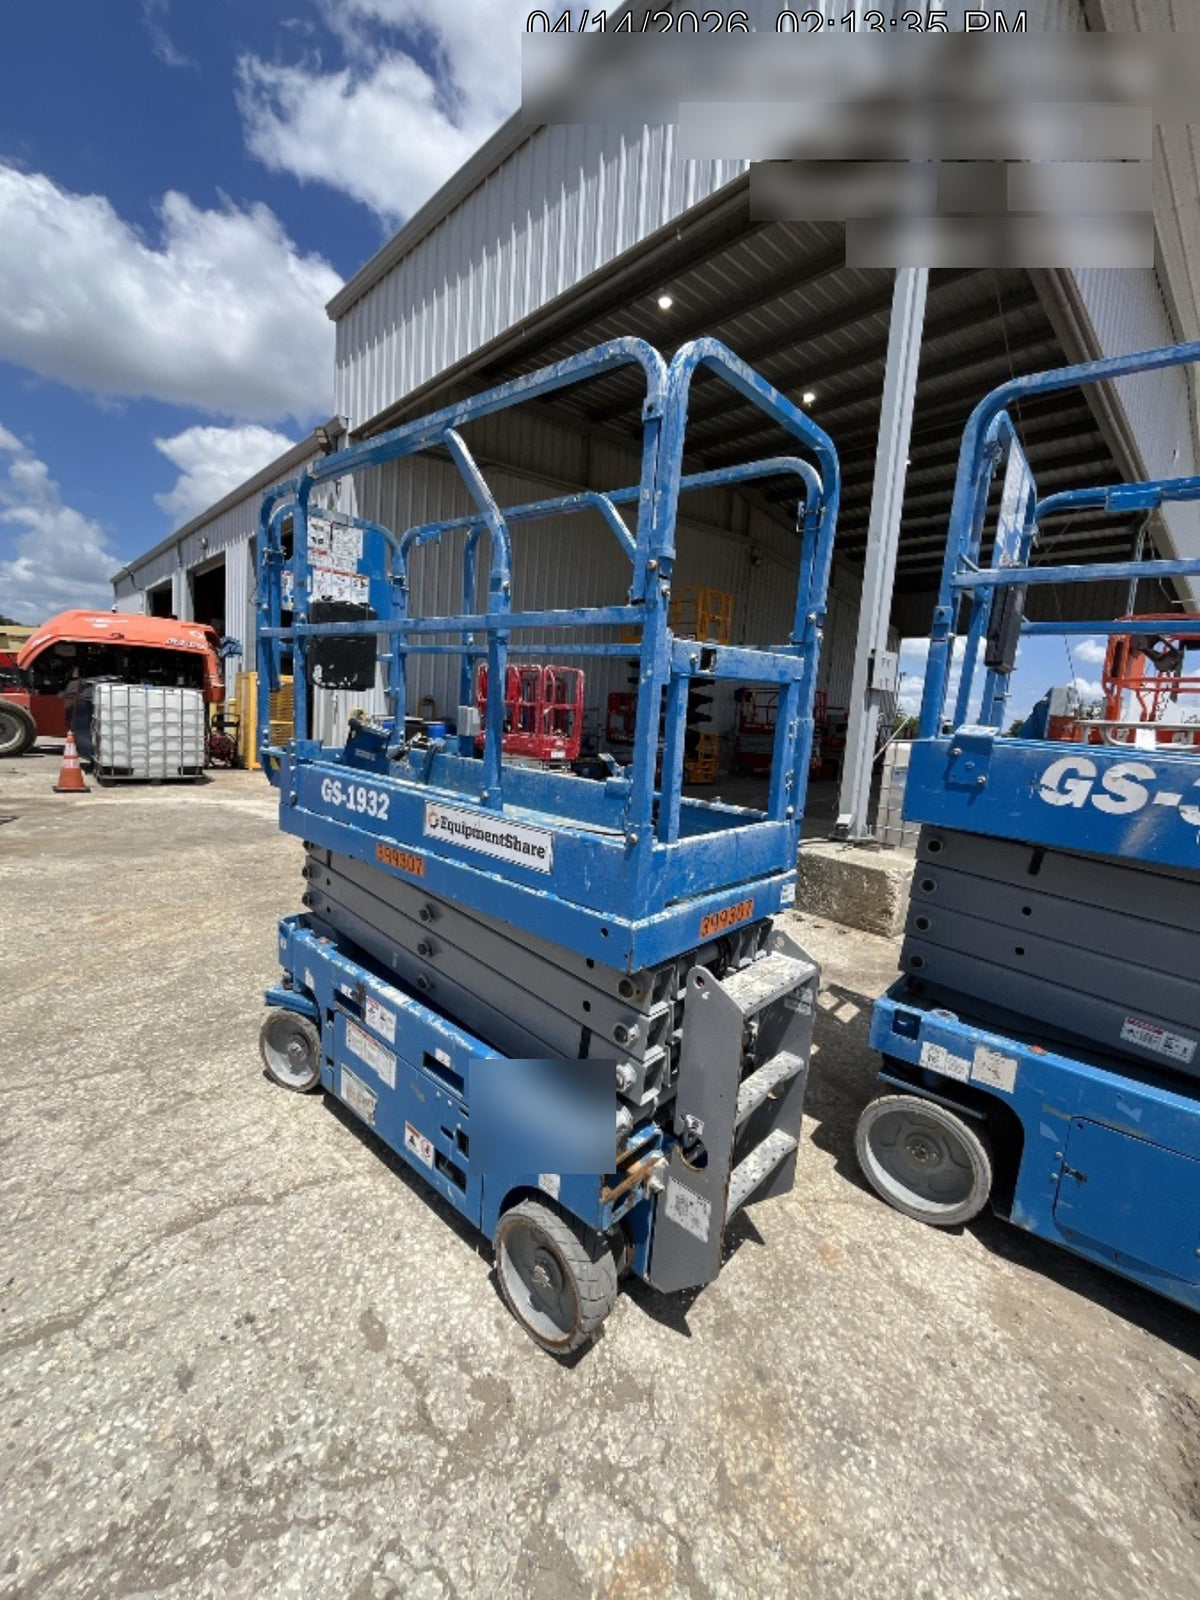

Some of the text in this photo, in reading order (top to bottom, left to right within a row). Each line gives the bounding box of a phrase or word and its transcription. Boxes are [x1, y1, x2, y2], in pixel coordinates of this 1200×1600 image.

[321, 778, 390, 820] GS-1932
[440, 815, 546, 859] EquipmentShare
[701, 899, 753, 937] 399307
